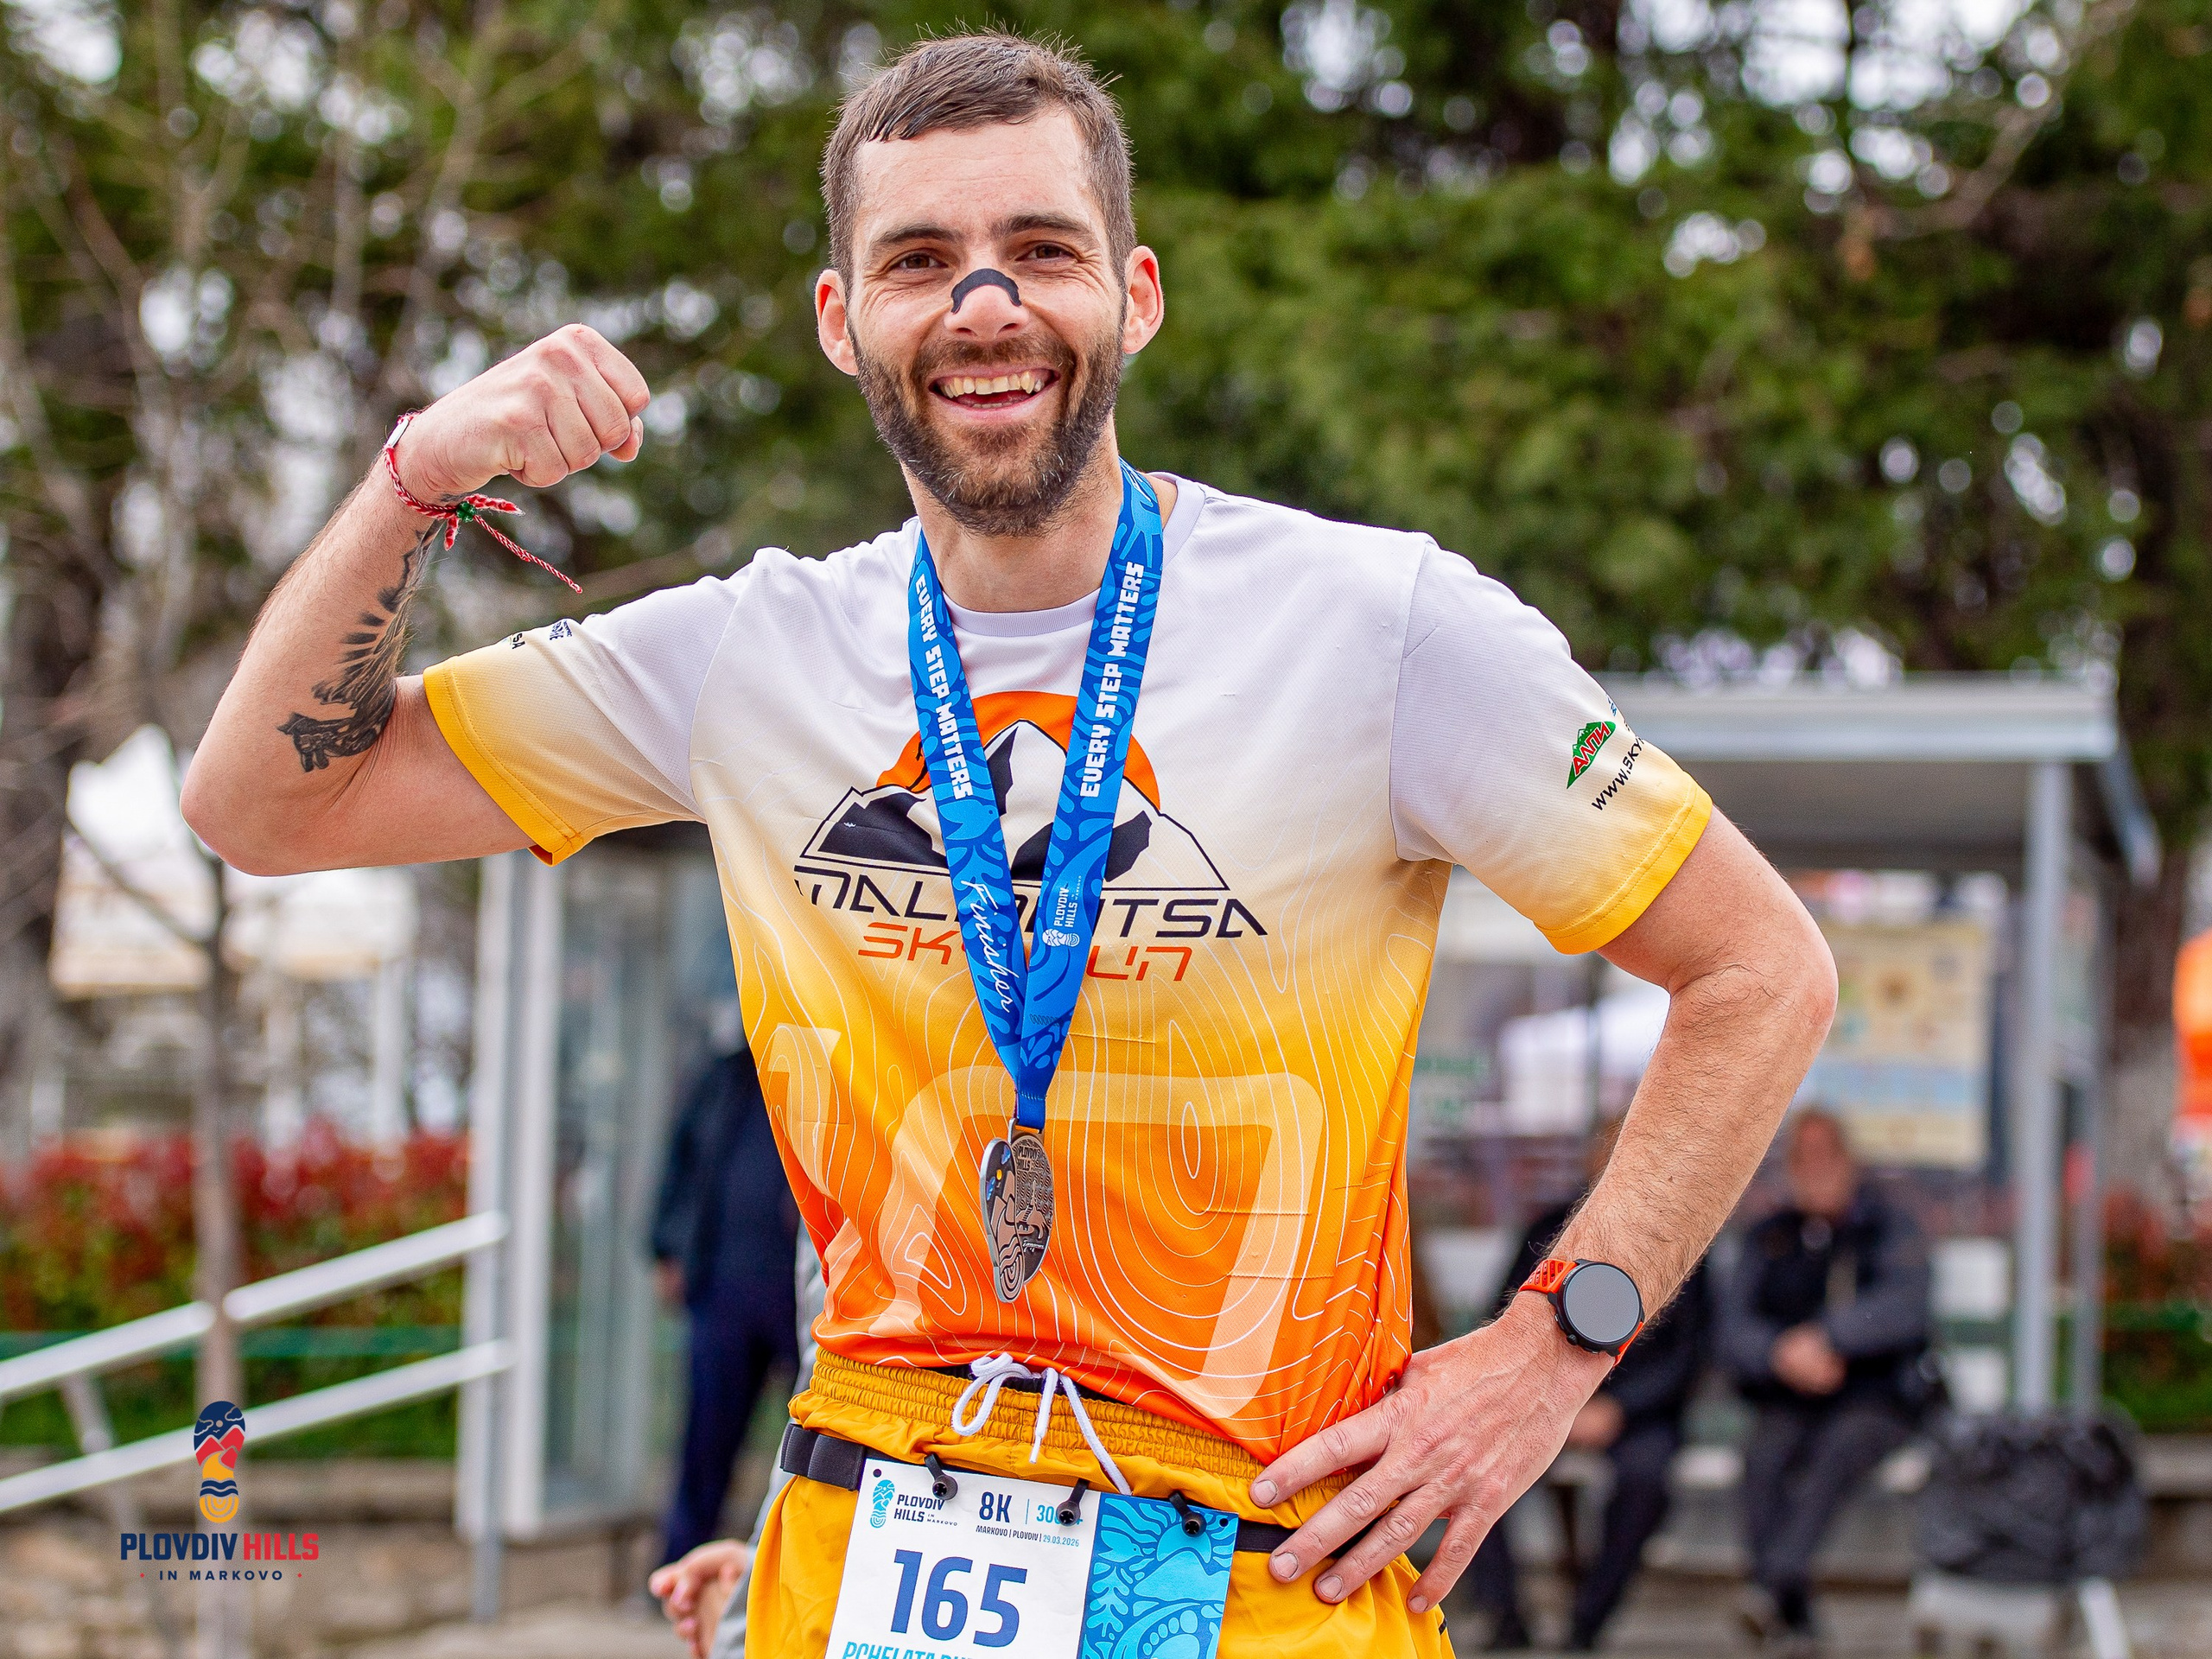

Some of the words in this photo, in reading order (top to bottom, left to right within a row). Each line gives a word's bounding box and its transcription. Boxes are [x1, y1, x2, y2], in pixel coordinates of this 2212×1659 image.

[1107, 561, 1145, 658] MATTERS
[925, 645, 950, 699] STEP
[1095, 663, 1123, 719] STEP
[936, 702, 973, 799] MATTERS
[793, 865, 1268, 938] MALITSA
[1053, 887, 1070, 926] PLOVDIV
[1064, 902, 1077, 927] HILLS
[858, 922, 1192, 982] SKUN
[961, 880, 1020, 1013] Finisher
[893, 1508, 925, 1522] HILLS
[897, 1494, 945, 1510] PLOVDIV
[978, 1491, 1012, 1522] 8K
[976, 1524, 1008, 1536] MARKOVO
[1012, 1529, 1039, 1542] PLOVDIV
[1043, 1534, 1080, 1547] 29.03.2026
[890, 1548, 1027, 1649] 165
